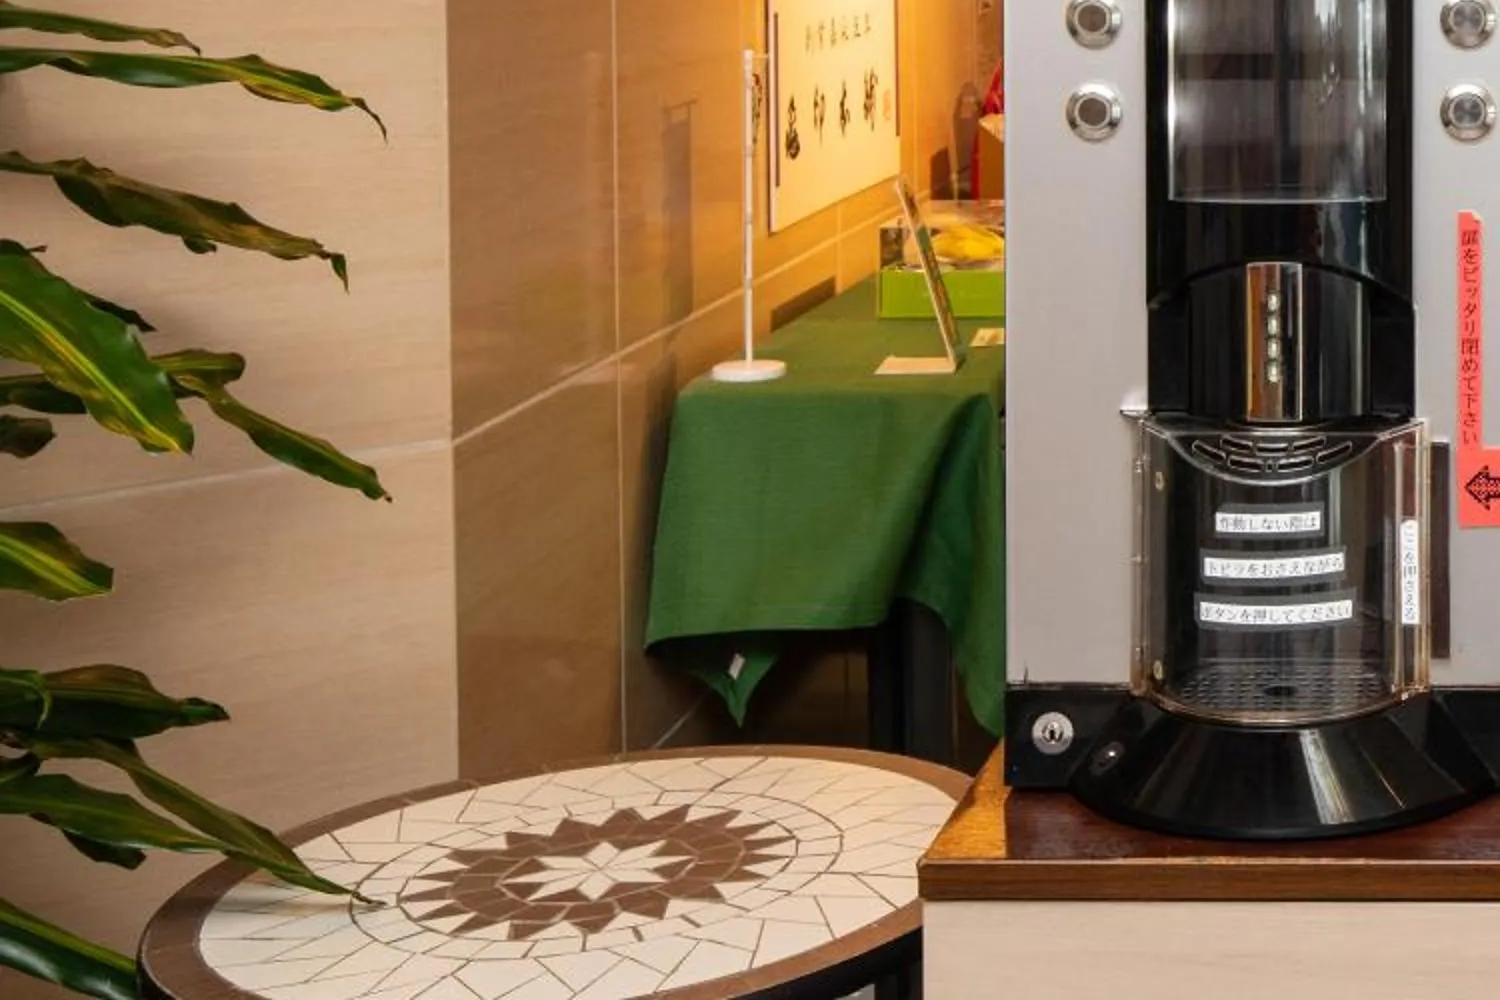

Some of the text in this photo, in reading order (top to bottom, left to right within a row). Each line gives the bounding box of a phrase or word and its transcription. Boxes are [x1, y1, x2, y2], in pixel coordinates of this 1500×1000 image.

[1460, 229, 1479, 445] 扉をピッタリ閉めて下さい
